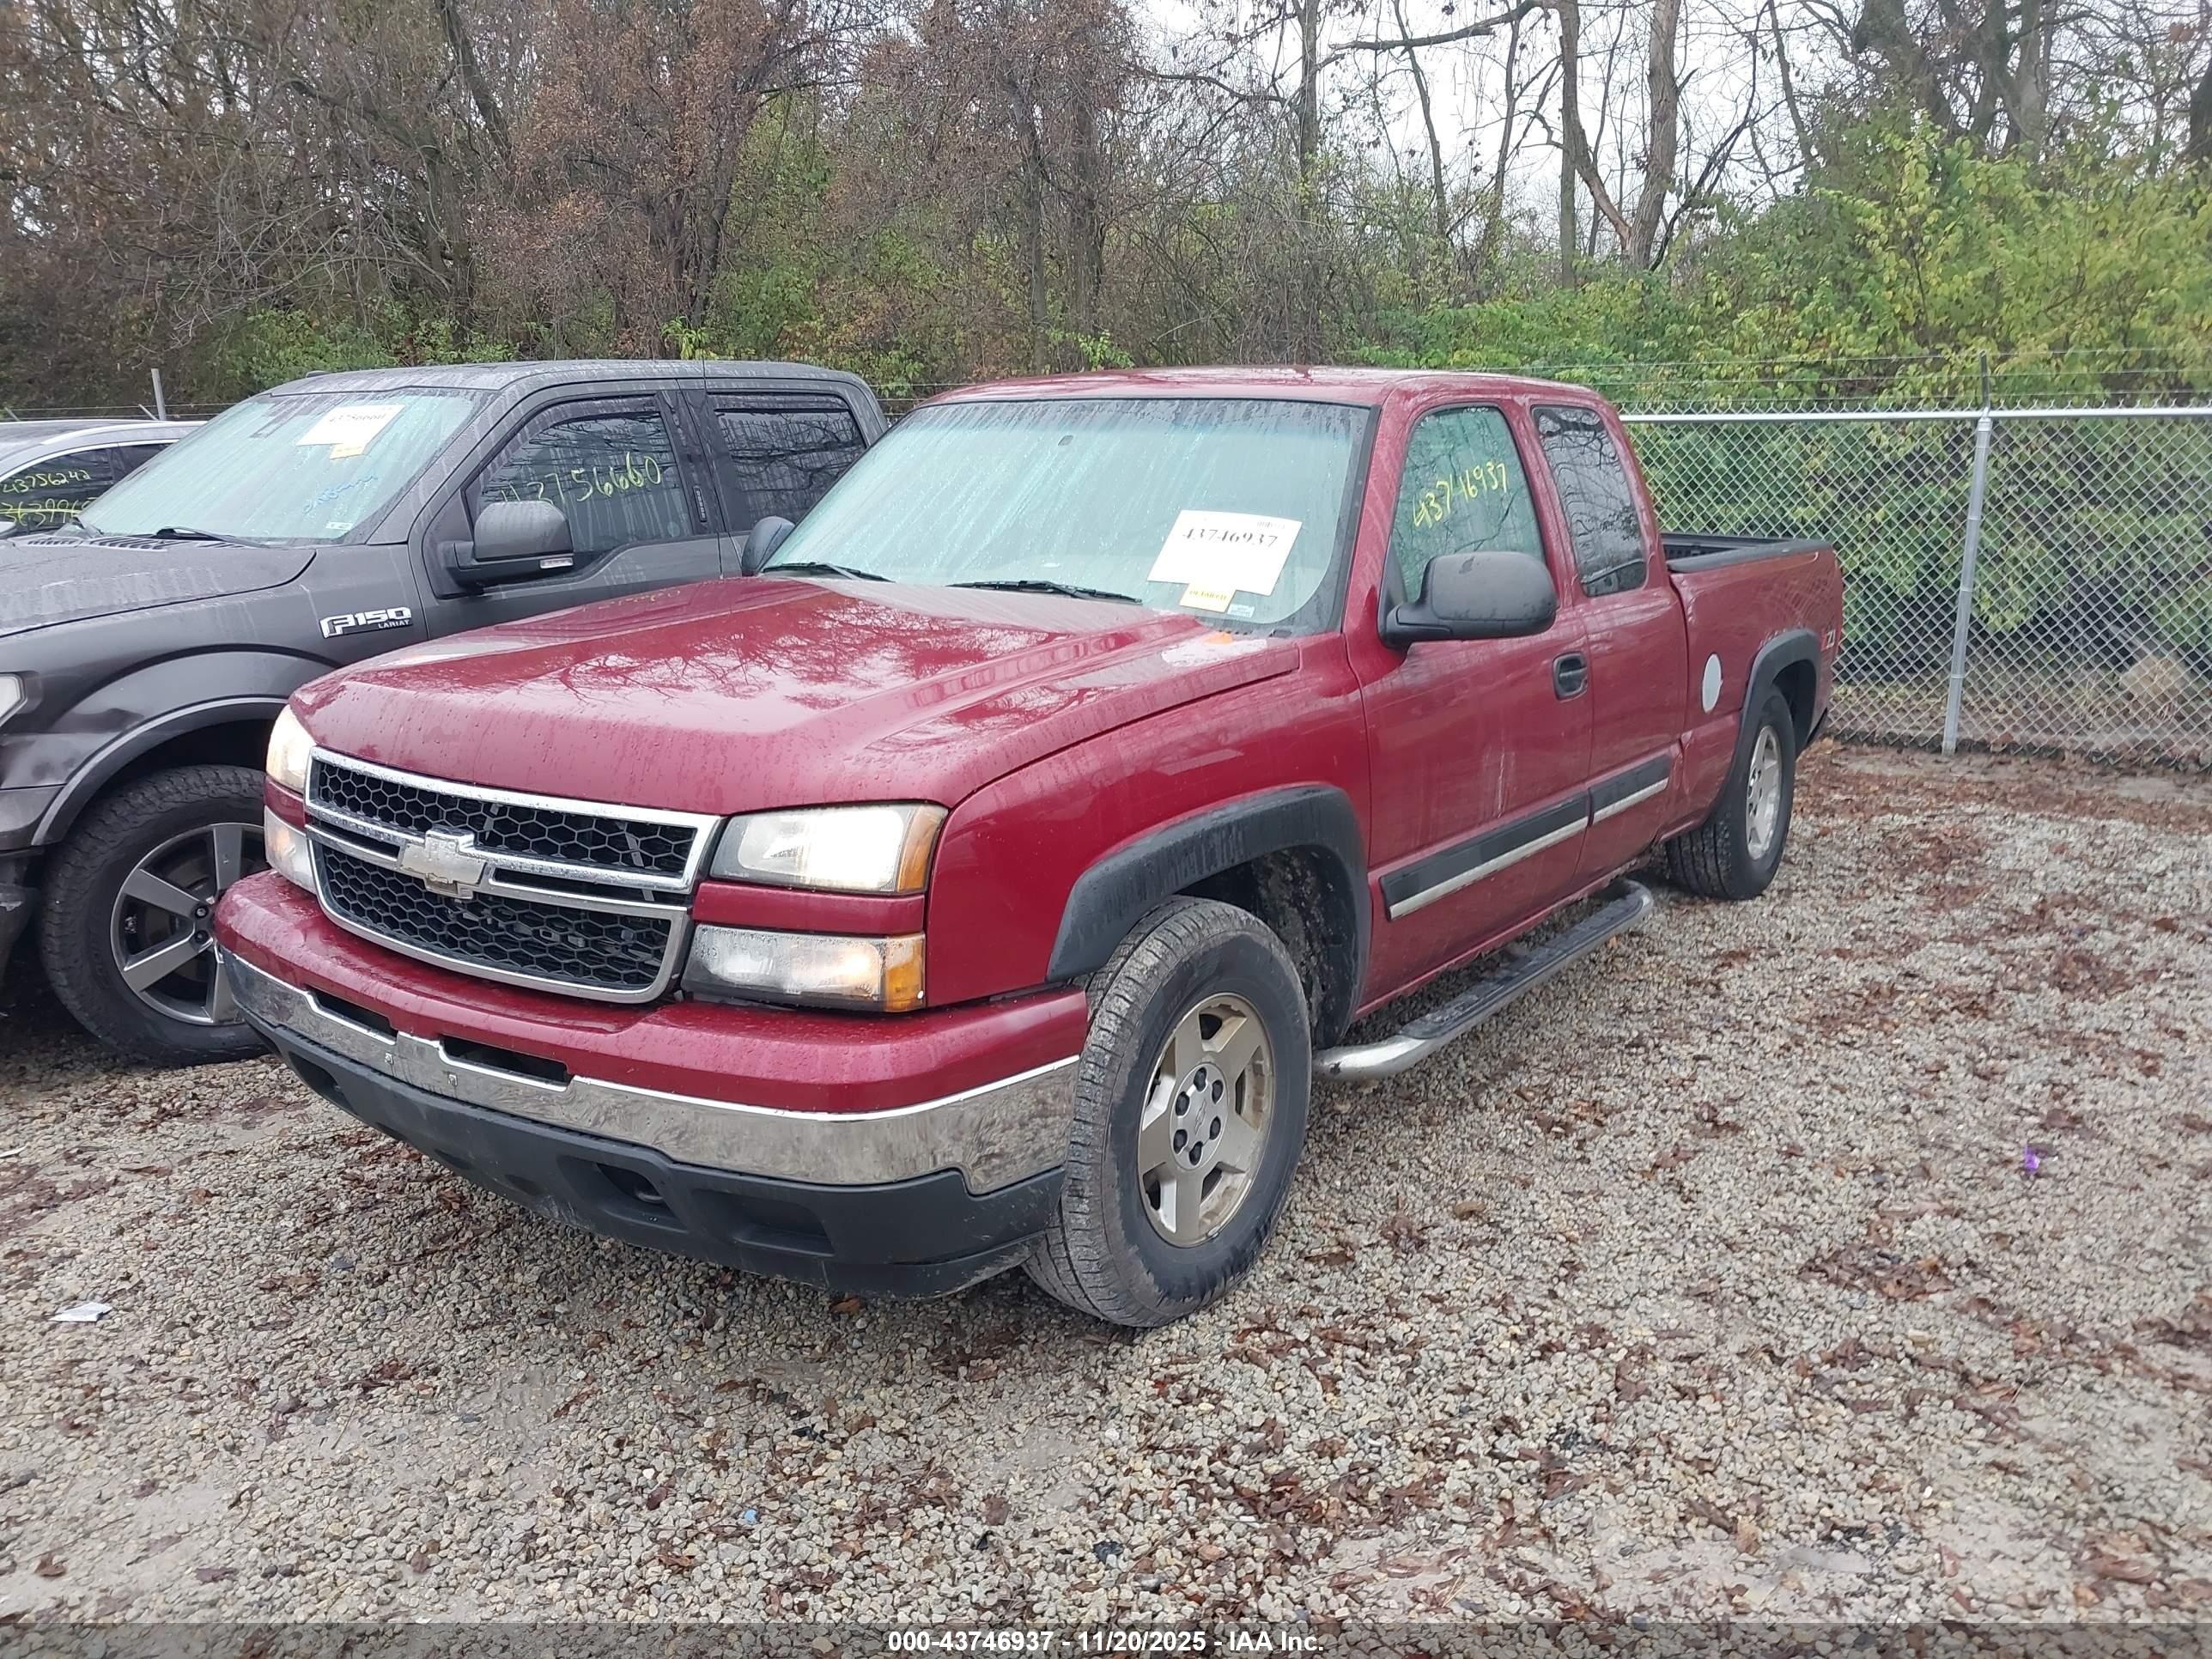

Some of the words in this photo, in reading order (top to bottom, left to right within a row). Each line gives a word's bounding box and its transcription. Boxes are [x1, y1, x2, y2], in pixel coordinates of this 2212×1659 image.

[2, 470, 92, 493] 43756242
[1413, 460, 1509, 529] 43746937
[1182, 527, 1279, 548] 43746937
[319, 606, 412, 638] F150
[378, 619, 410, 629] LARIAT
